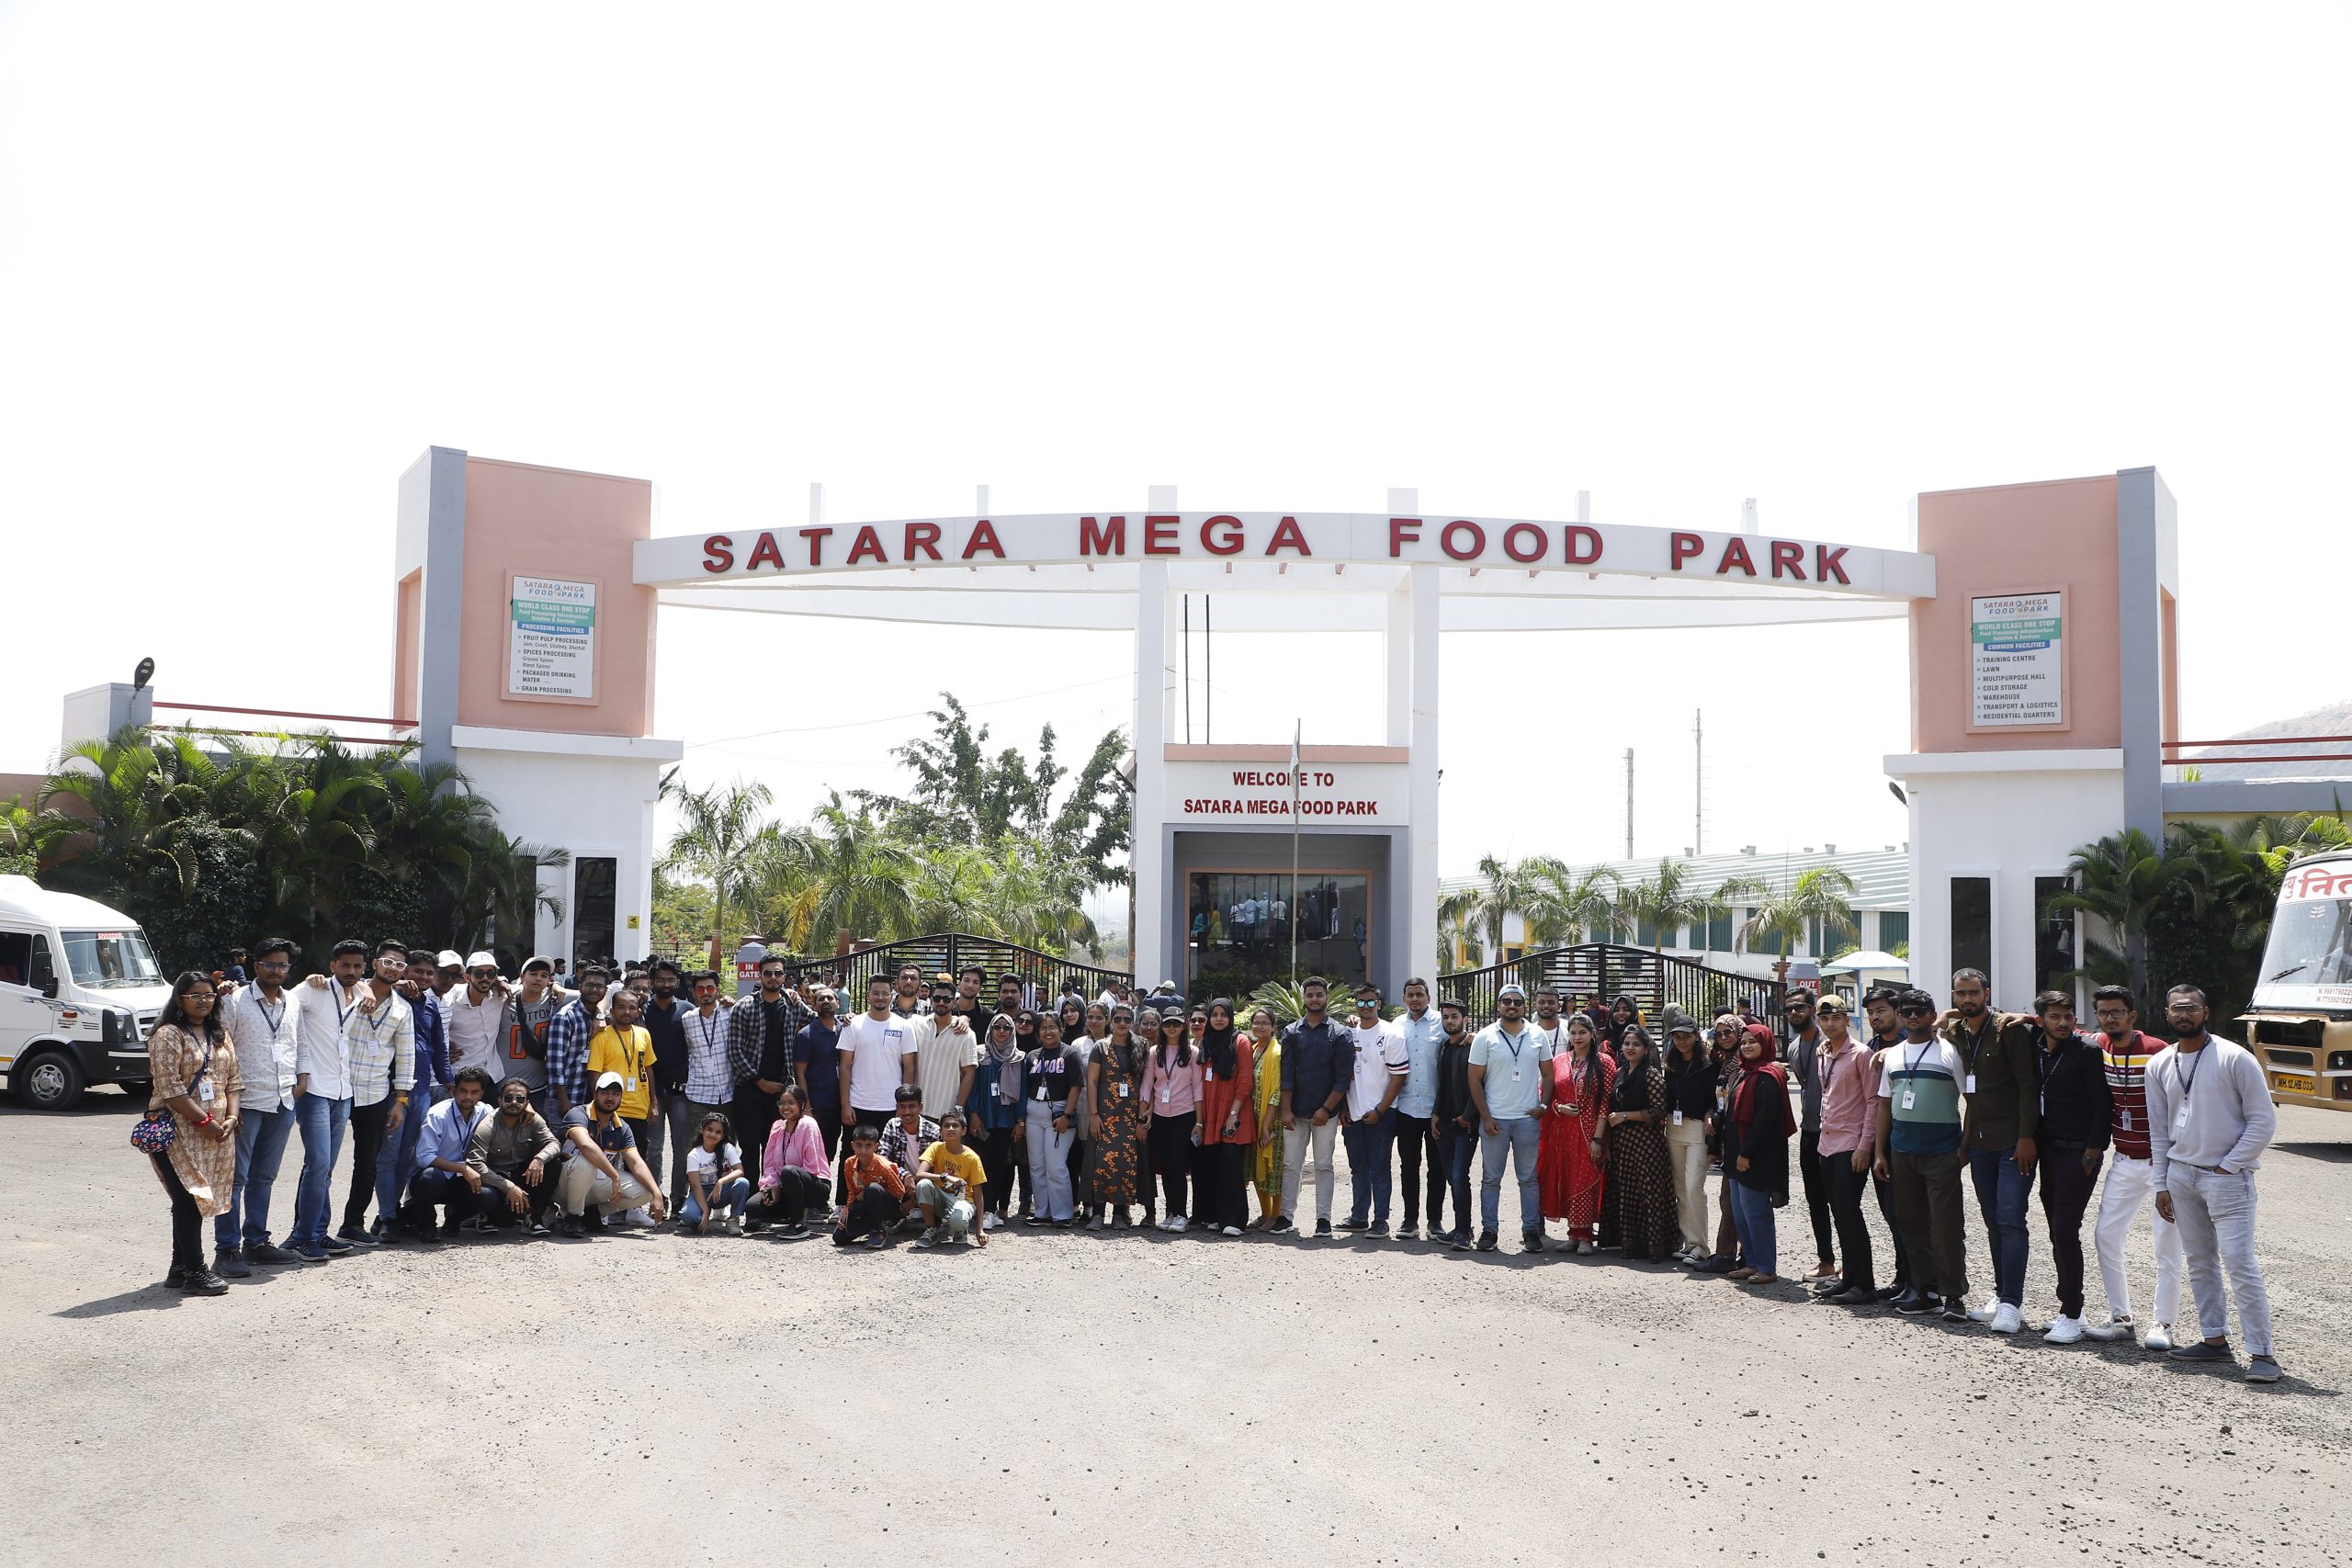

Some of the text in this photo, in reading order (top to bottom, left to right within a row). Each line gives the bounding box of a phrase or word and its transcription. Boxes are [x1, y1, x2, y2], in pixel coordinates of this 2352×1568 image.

[703, 515, 1851, 584] SATARA MEGA FOOD PARK
[524, 581, 553, 590] SATARA
[1984, 601, 2014, 609] SATARA
[522, 623, 584, 634] PROCESSING FACILITIES
[2003, 621, 2022, 629] CLASS
[1233, 772, 1334, 786] WELCOE TO
[1184, 799, 1377, 815] SATARA MEGA FOOD PARK
[510, 1010, 551, 1022] VTTON
